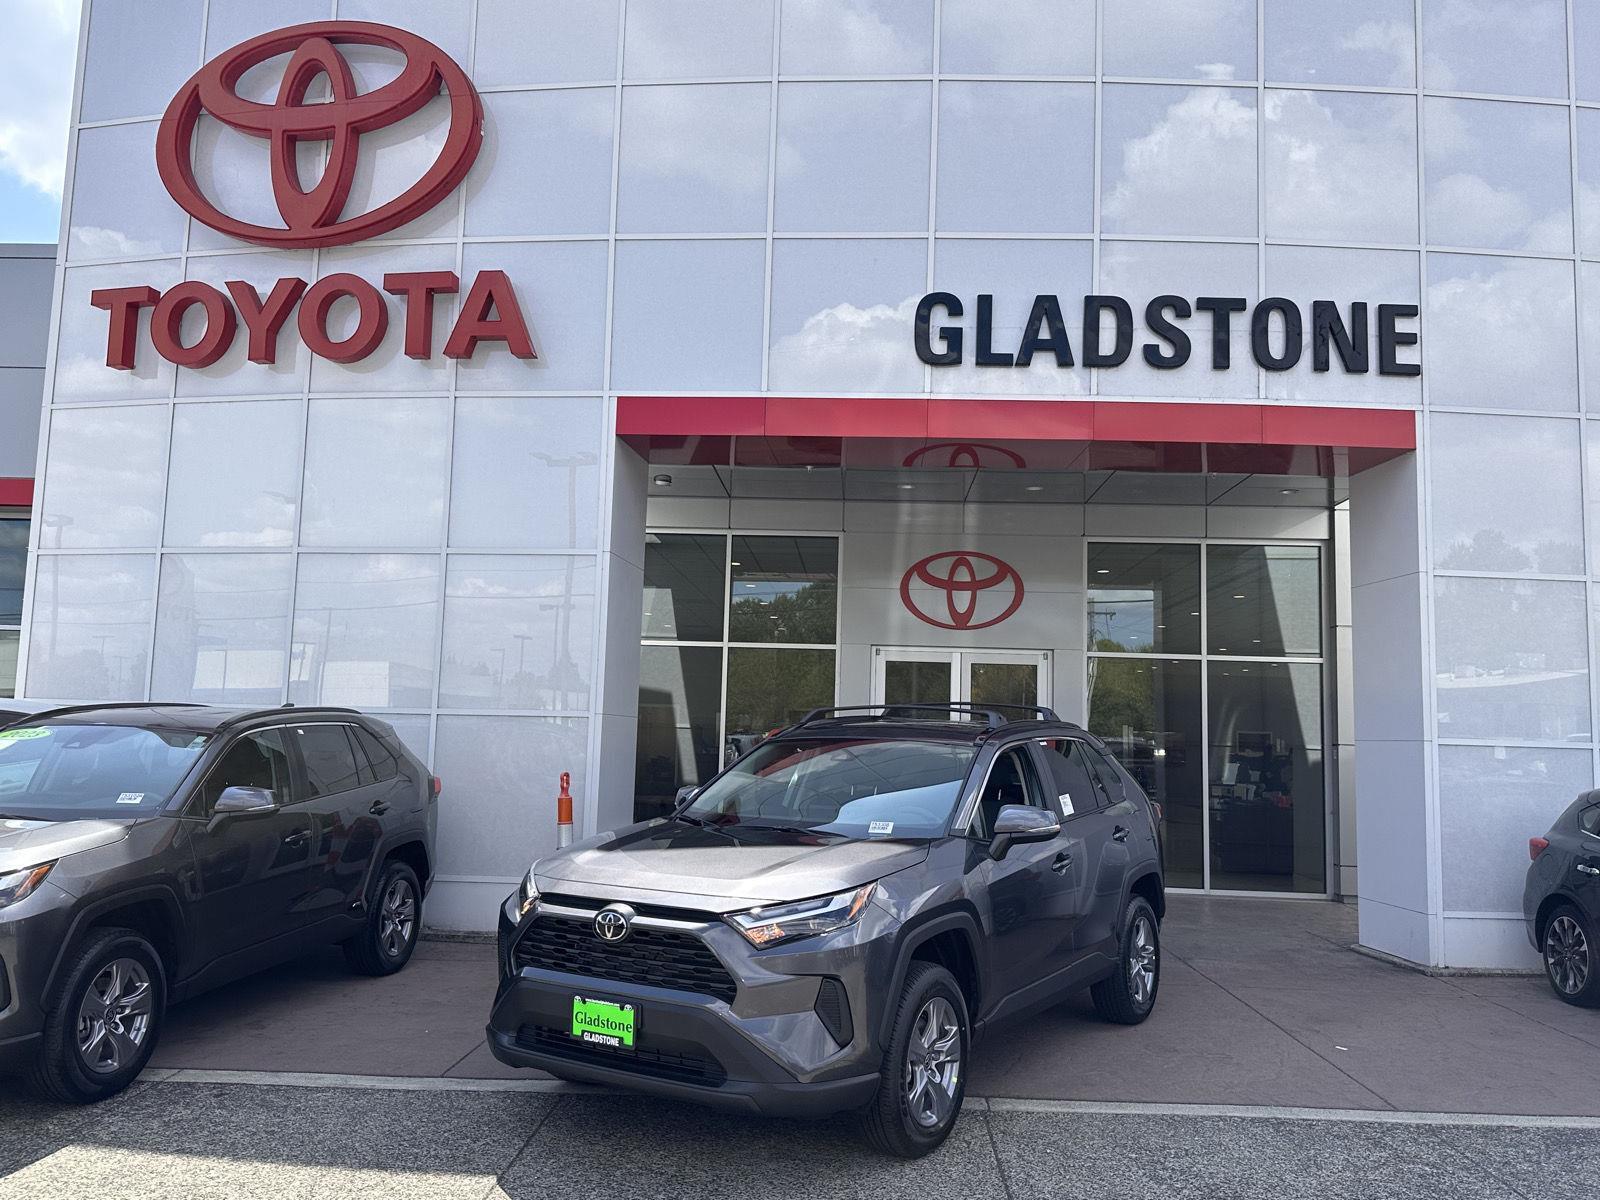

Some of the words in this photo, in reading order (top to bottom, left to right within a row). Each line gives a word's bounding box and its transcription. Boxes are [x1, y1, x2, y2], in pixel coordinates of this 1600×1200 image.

[91, 270, 537, 370] TOYOTA
[914, 292, 1421, 377] GLADSTONE
[575, 1011, 632, 1033] Gladstone
[583, 1032, 620, 1046] GLADSTONE
